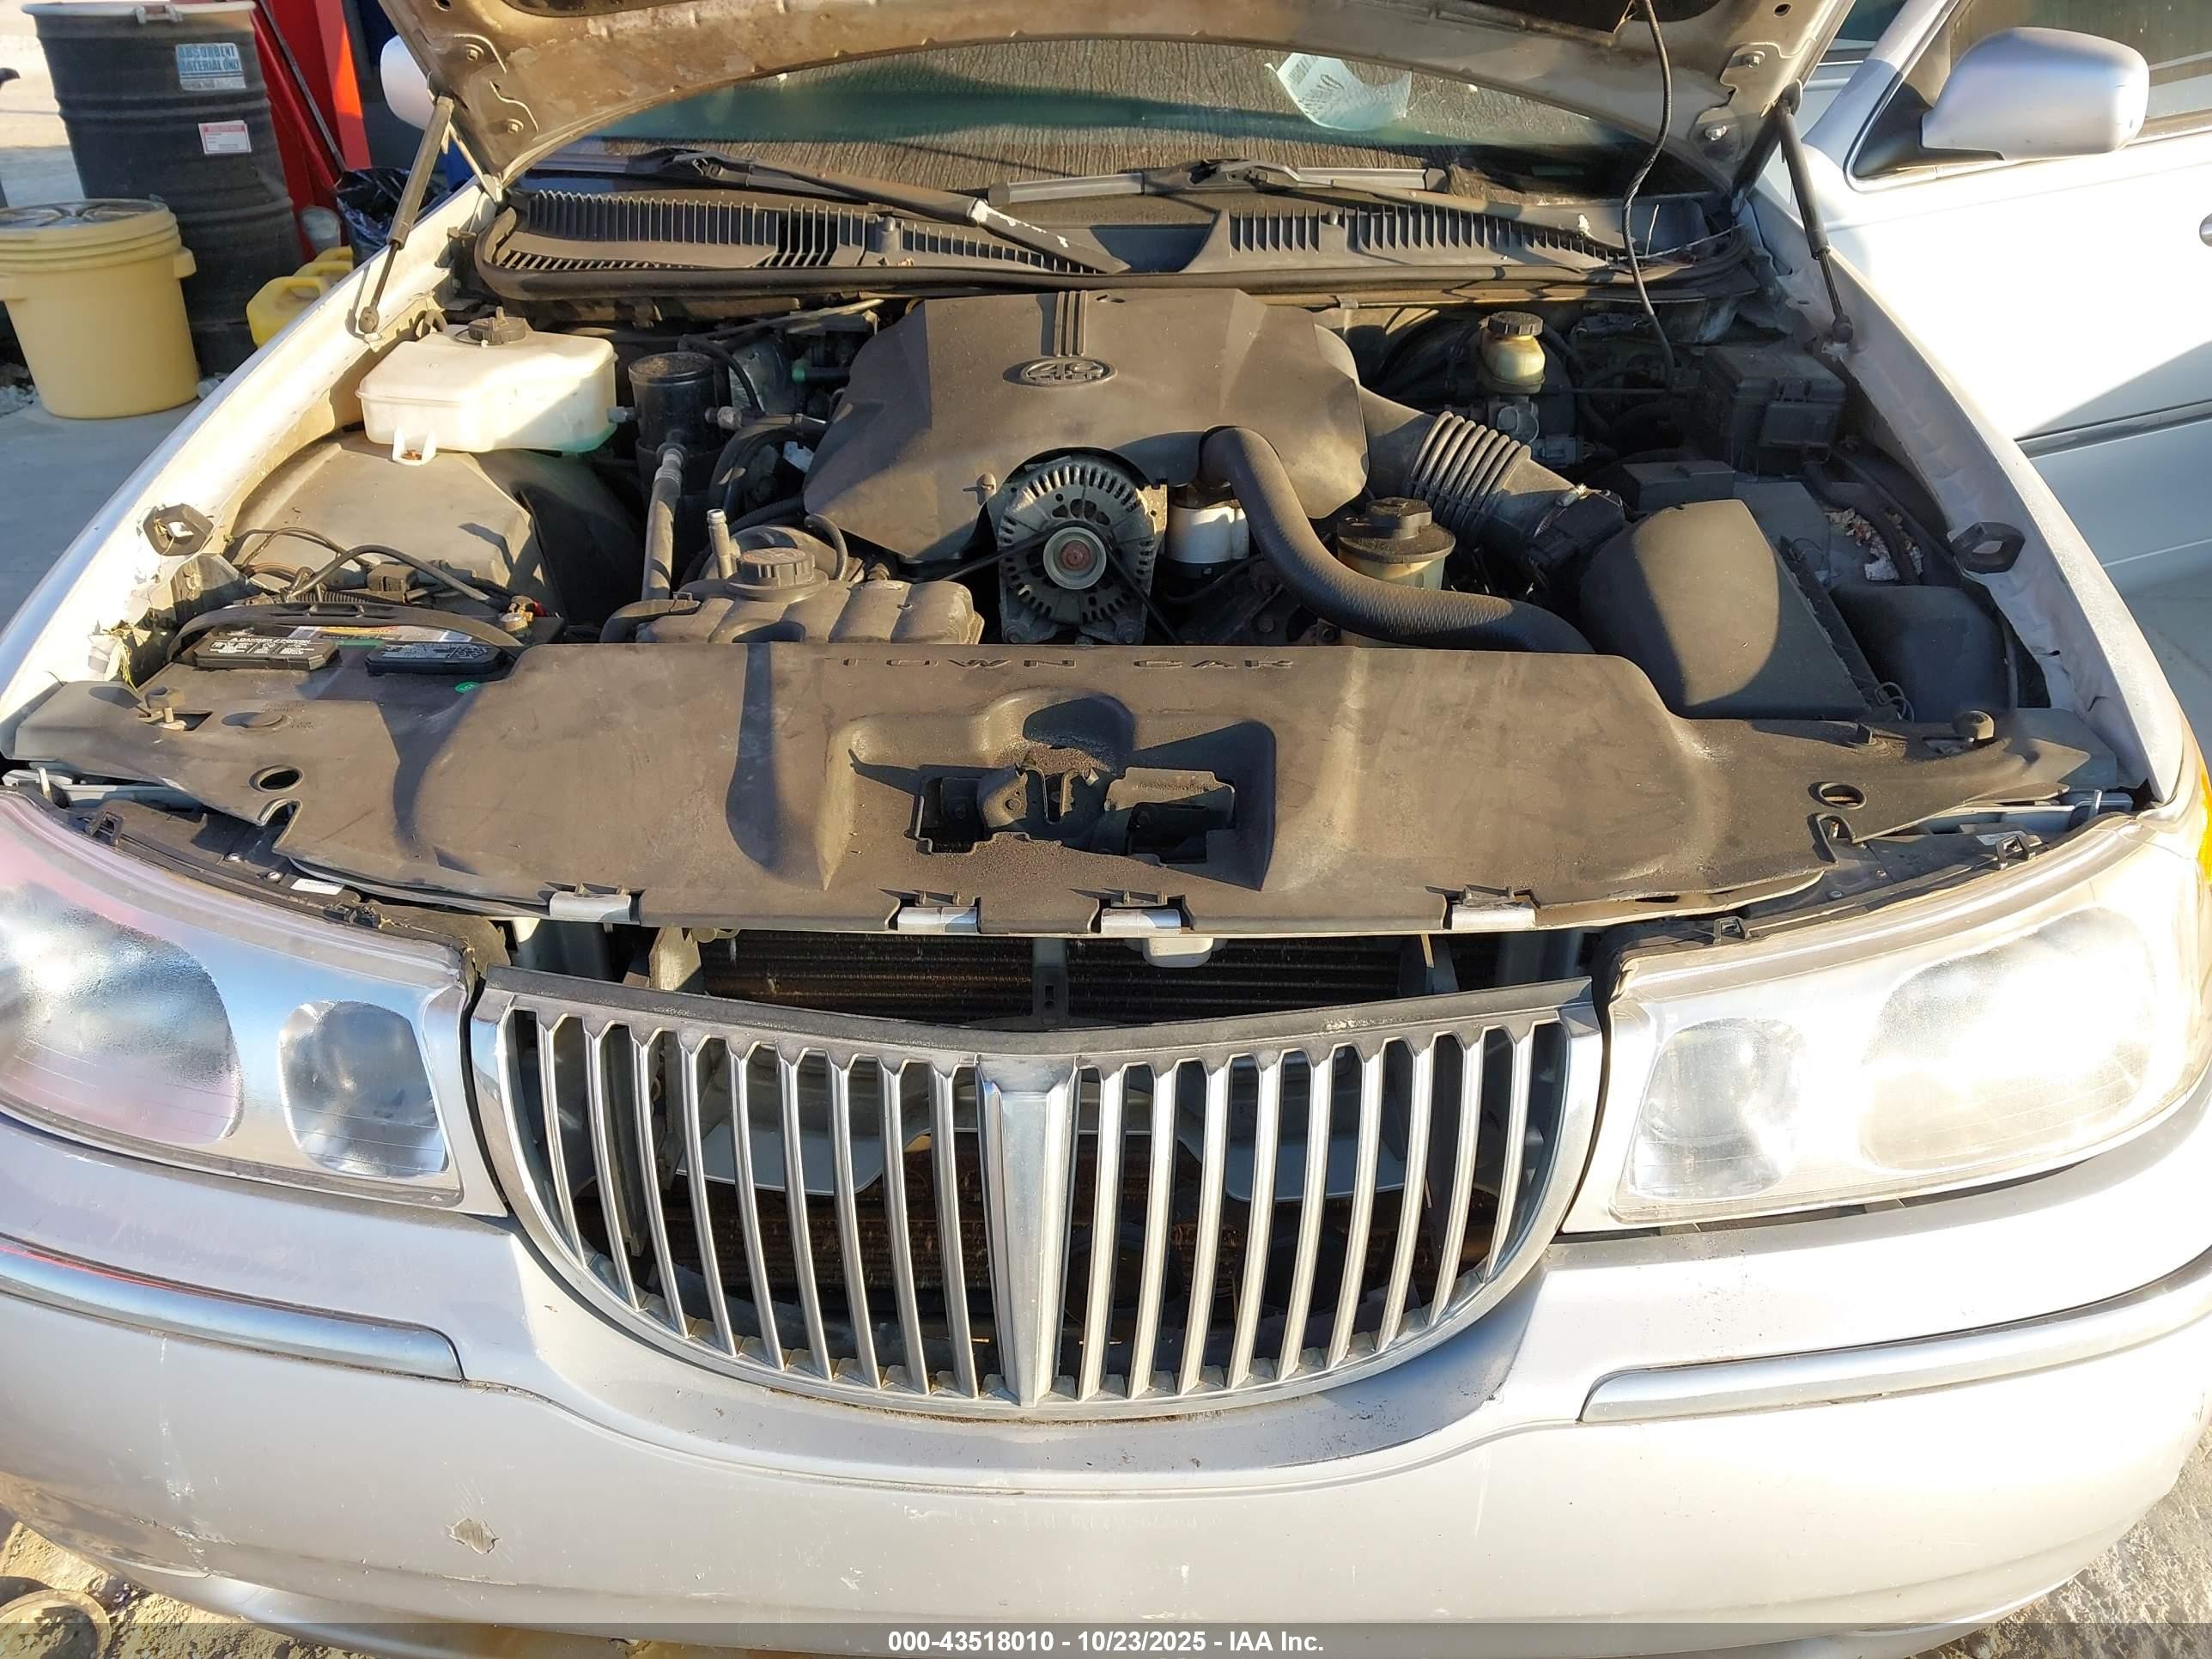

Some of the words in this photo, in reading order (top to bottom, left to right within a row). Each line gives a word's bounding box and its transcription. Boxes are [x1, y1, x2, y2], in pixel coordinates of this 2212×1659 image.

[179, 46, 234, 58] ABSORBENT
[179, 60, 222, 71] MATERIAL
[826, 658, 1077, 669] TOWN
[1133, 659, 1293, 669] CAR
